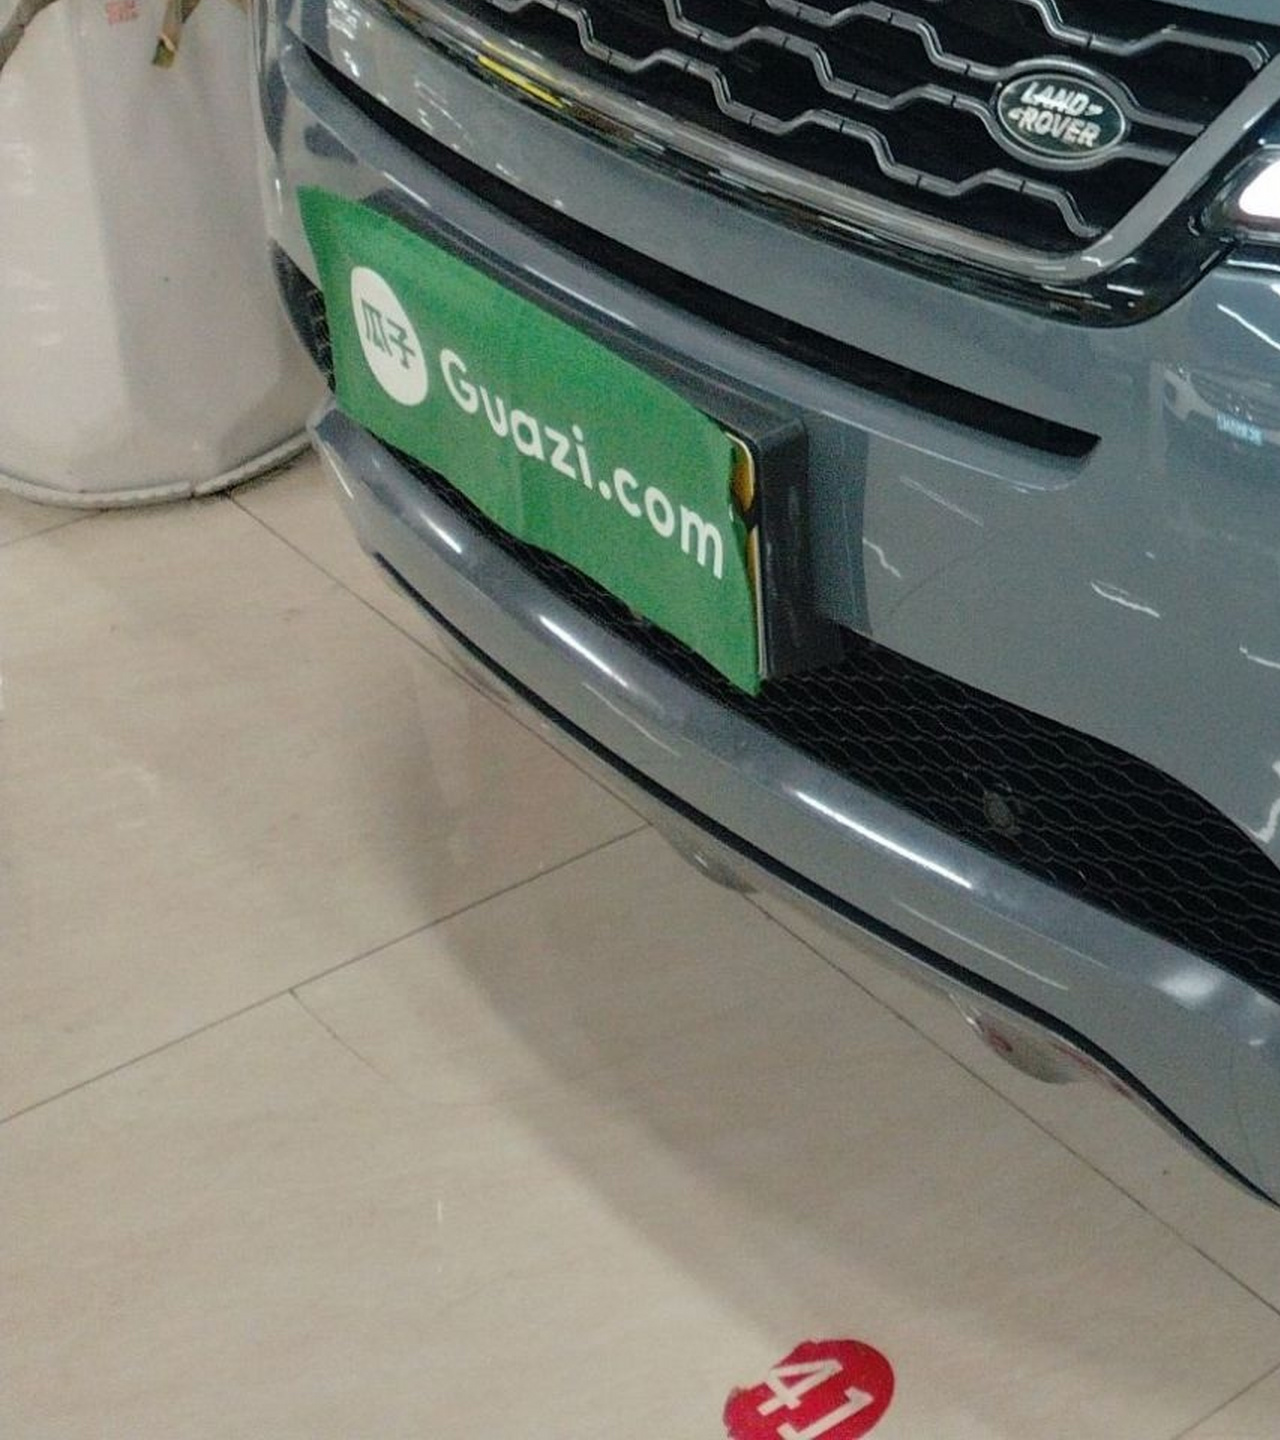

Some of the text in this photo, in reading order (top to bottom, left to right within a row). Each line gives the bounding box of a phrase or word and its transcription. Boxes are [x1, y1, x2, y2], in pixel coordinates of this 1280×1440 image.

[1017, 106, 1102, 148] ROVER
[1020, 82, 1090, 117] LAND
[360, 299, 416, 371] 瓜子
[439, 346, 726, 580] Guazi.com
